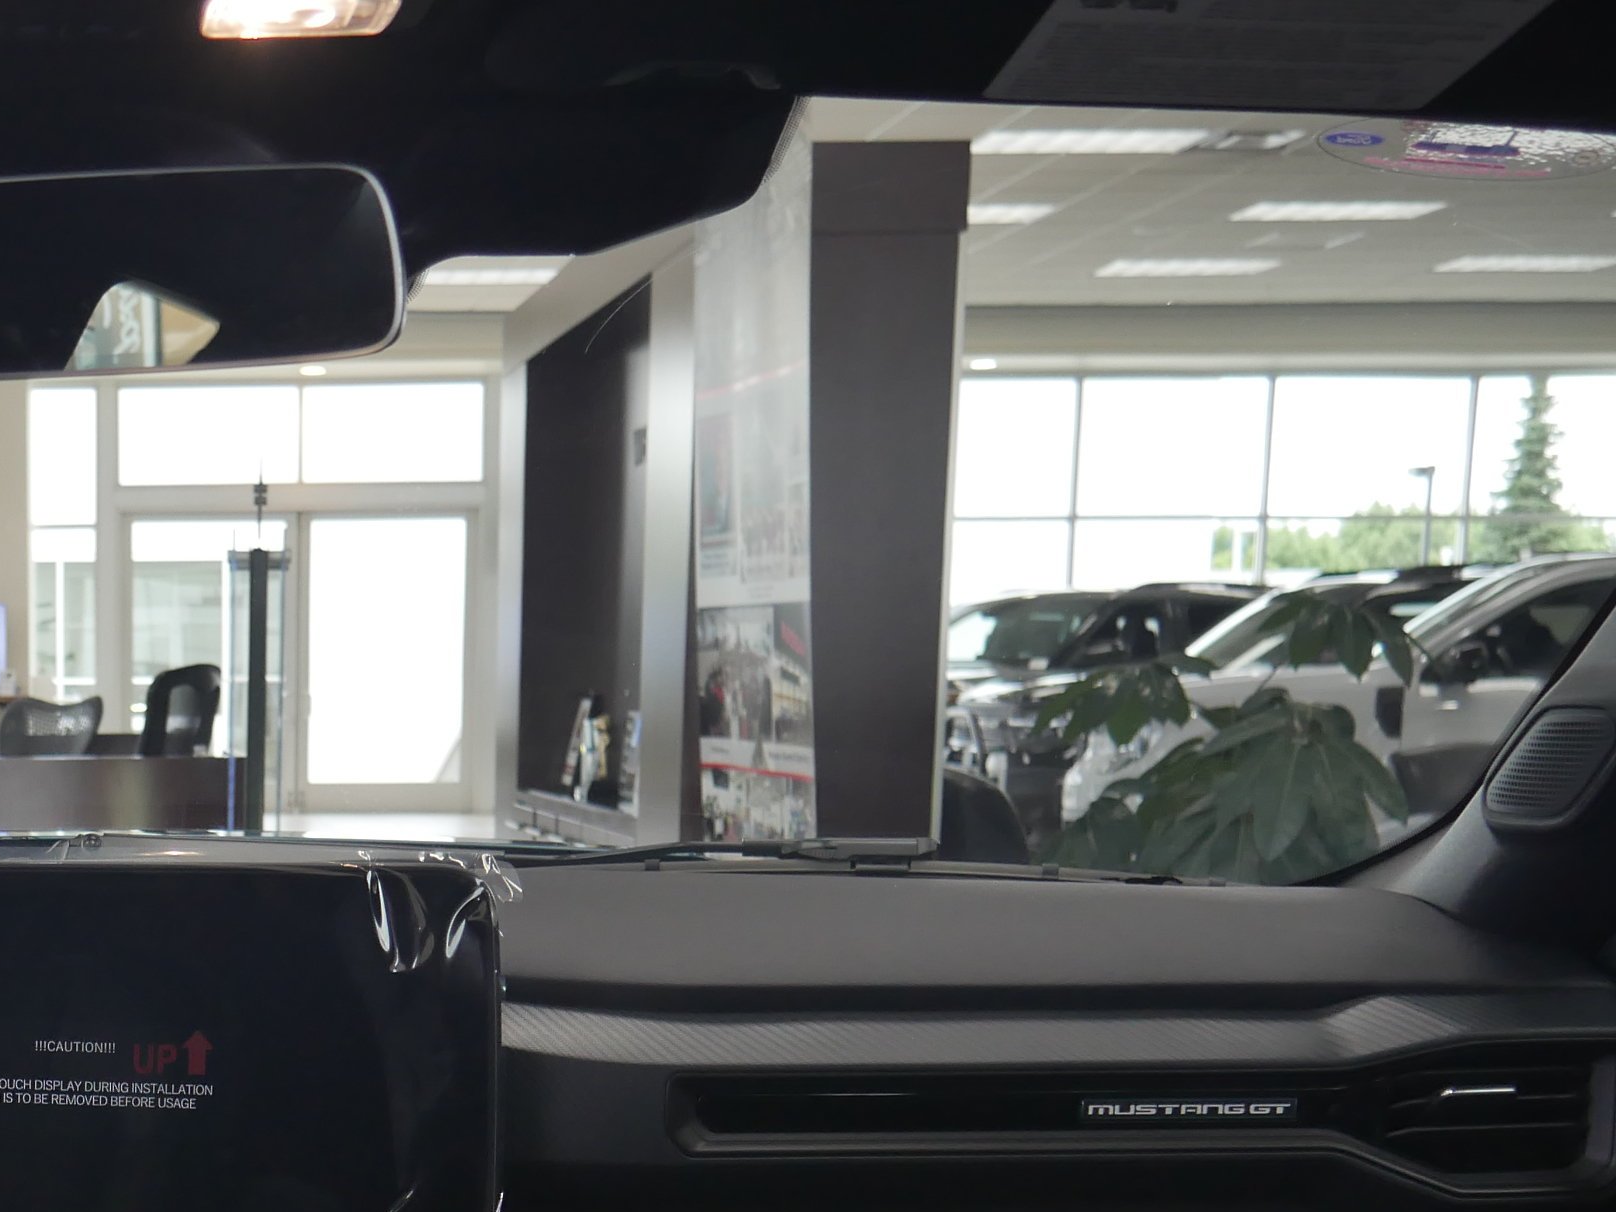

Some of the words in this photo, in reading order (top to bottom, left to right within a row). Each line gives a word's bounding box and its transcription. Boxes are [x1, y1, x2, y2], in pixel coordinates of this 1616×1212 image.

[34, 1040, 116, 1054] !!!CAUTION!!!
[133, 1043, 178, 1075] UP
[34, 1079, 82, 1092] DISPLAY
[84, 1081, 129, 1093] DURING
[131, 1082, 213, 1096] INSTALLATION
[3, 1092, 13, 1104] IS
[15, 1092, 32, 1104] TO
[34, 1093, 49, 1105] BE
[51, 1093, 108, 1107] REMOVED
[110, 1095, 155, 1108] BEFORE
[157, 1097, 196, 1109] USAGE
[1087, 1103, 1245, 1116] MUSTANG
[1249, 1103, 1291, 1115] GT
